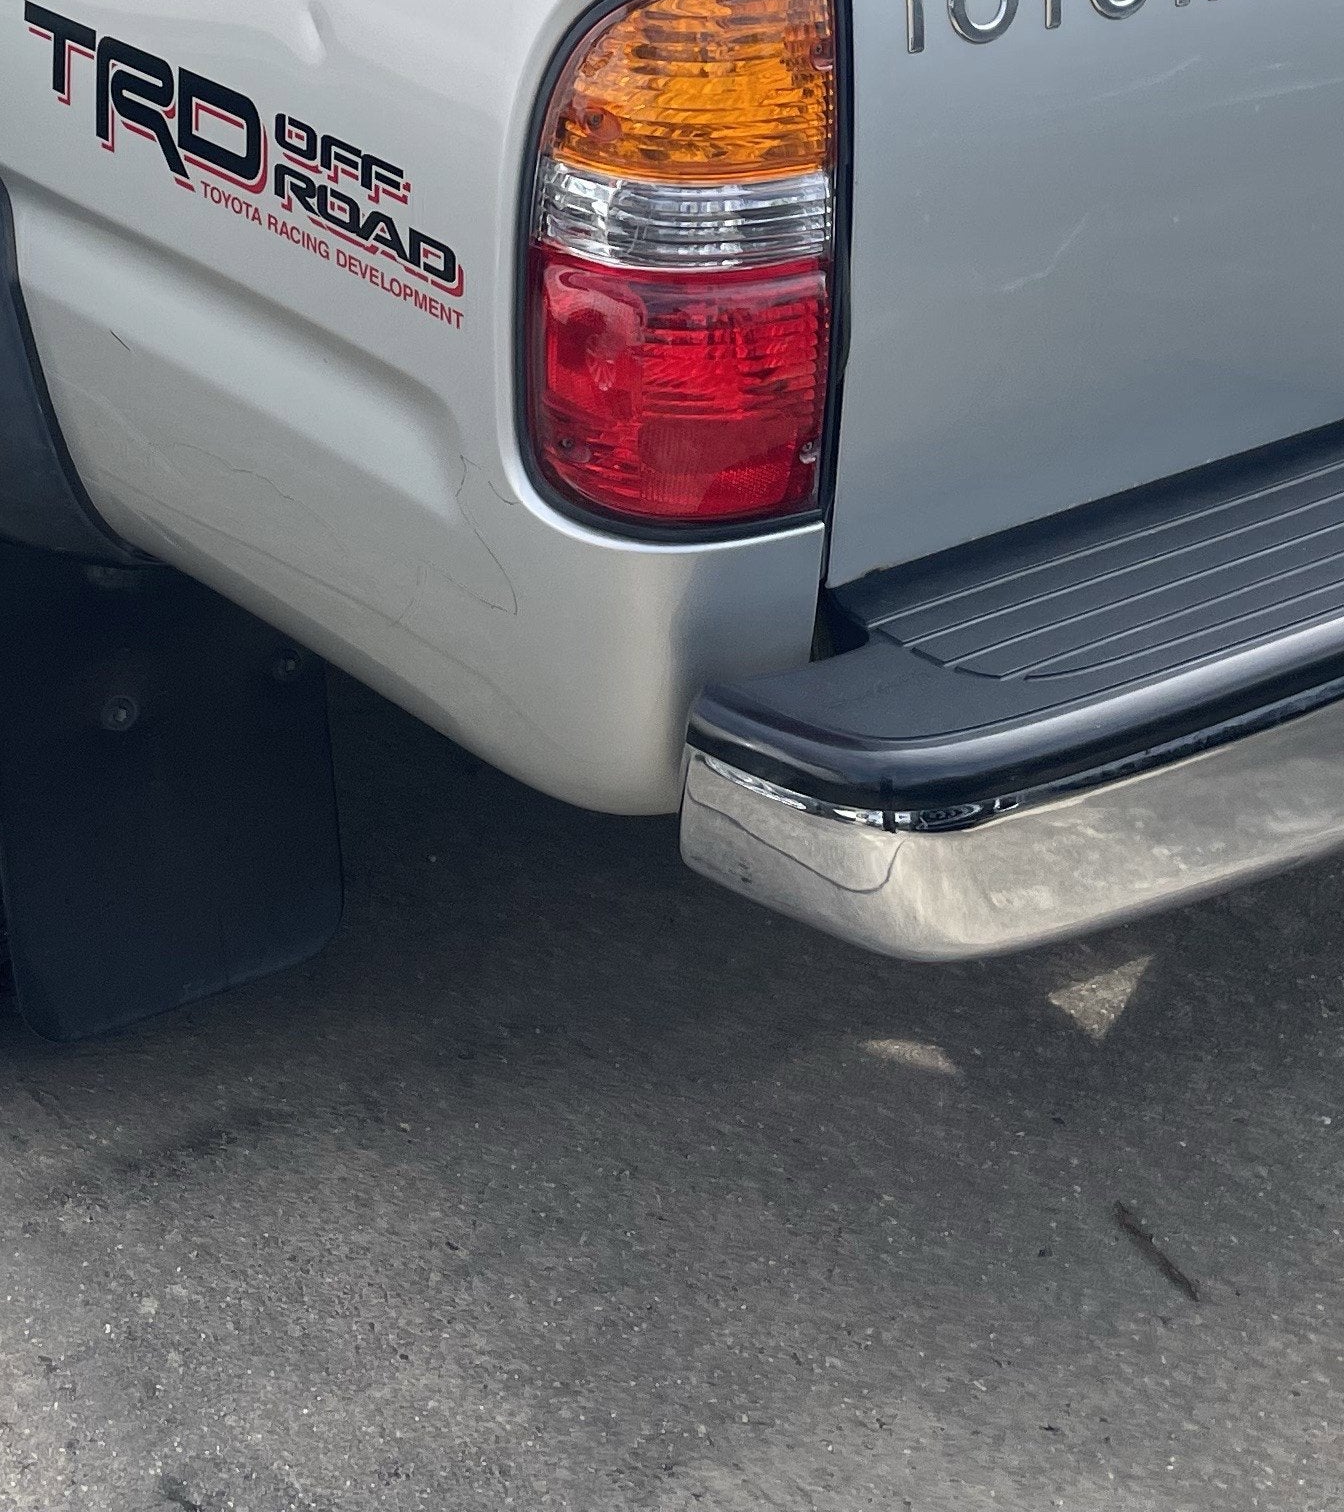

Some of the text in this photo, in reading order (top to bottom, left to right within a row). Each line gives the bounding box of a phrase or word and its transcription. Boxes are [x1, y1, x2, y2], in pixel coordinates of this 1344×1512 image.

[24, 0, 268, 195] TRD
[274, 112, 412, 205] OFF
[200, 179, 465, 330] TOYOTA RACING DEVELOPMENT
[274, 163, 465, 298] ROAD
